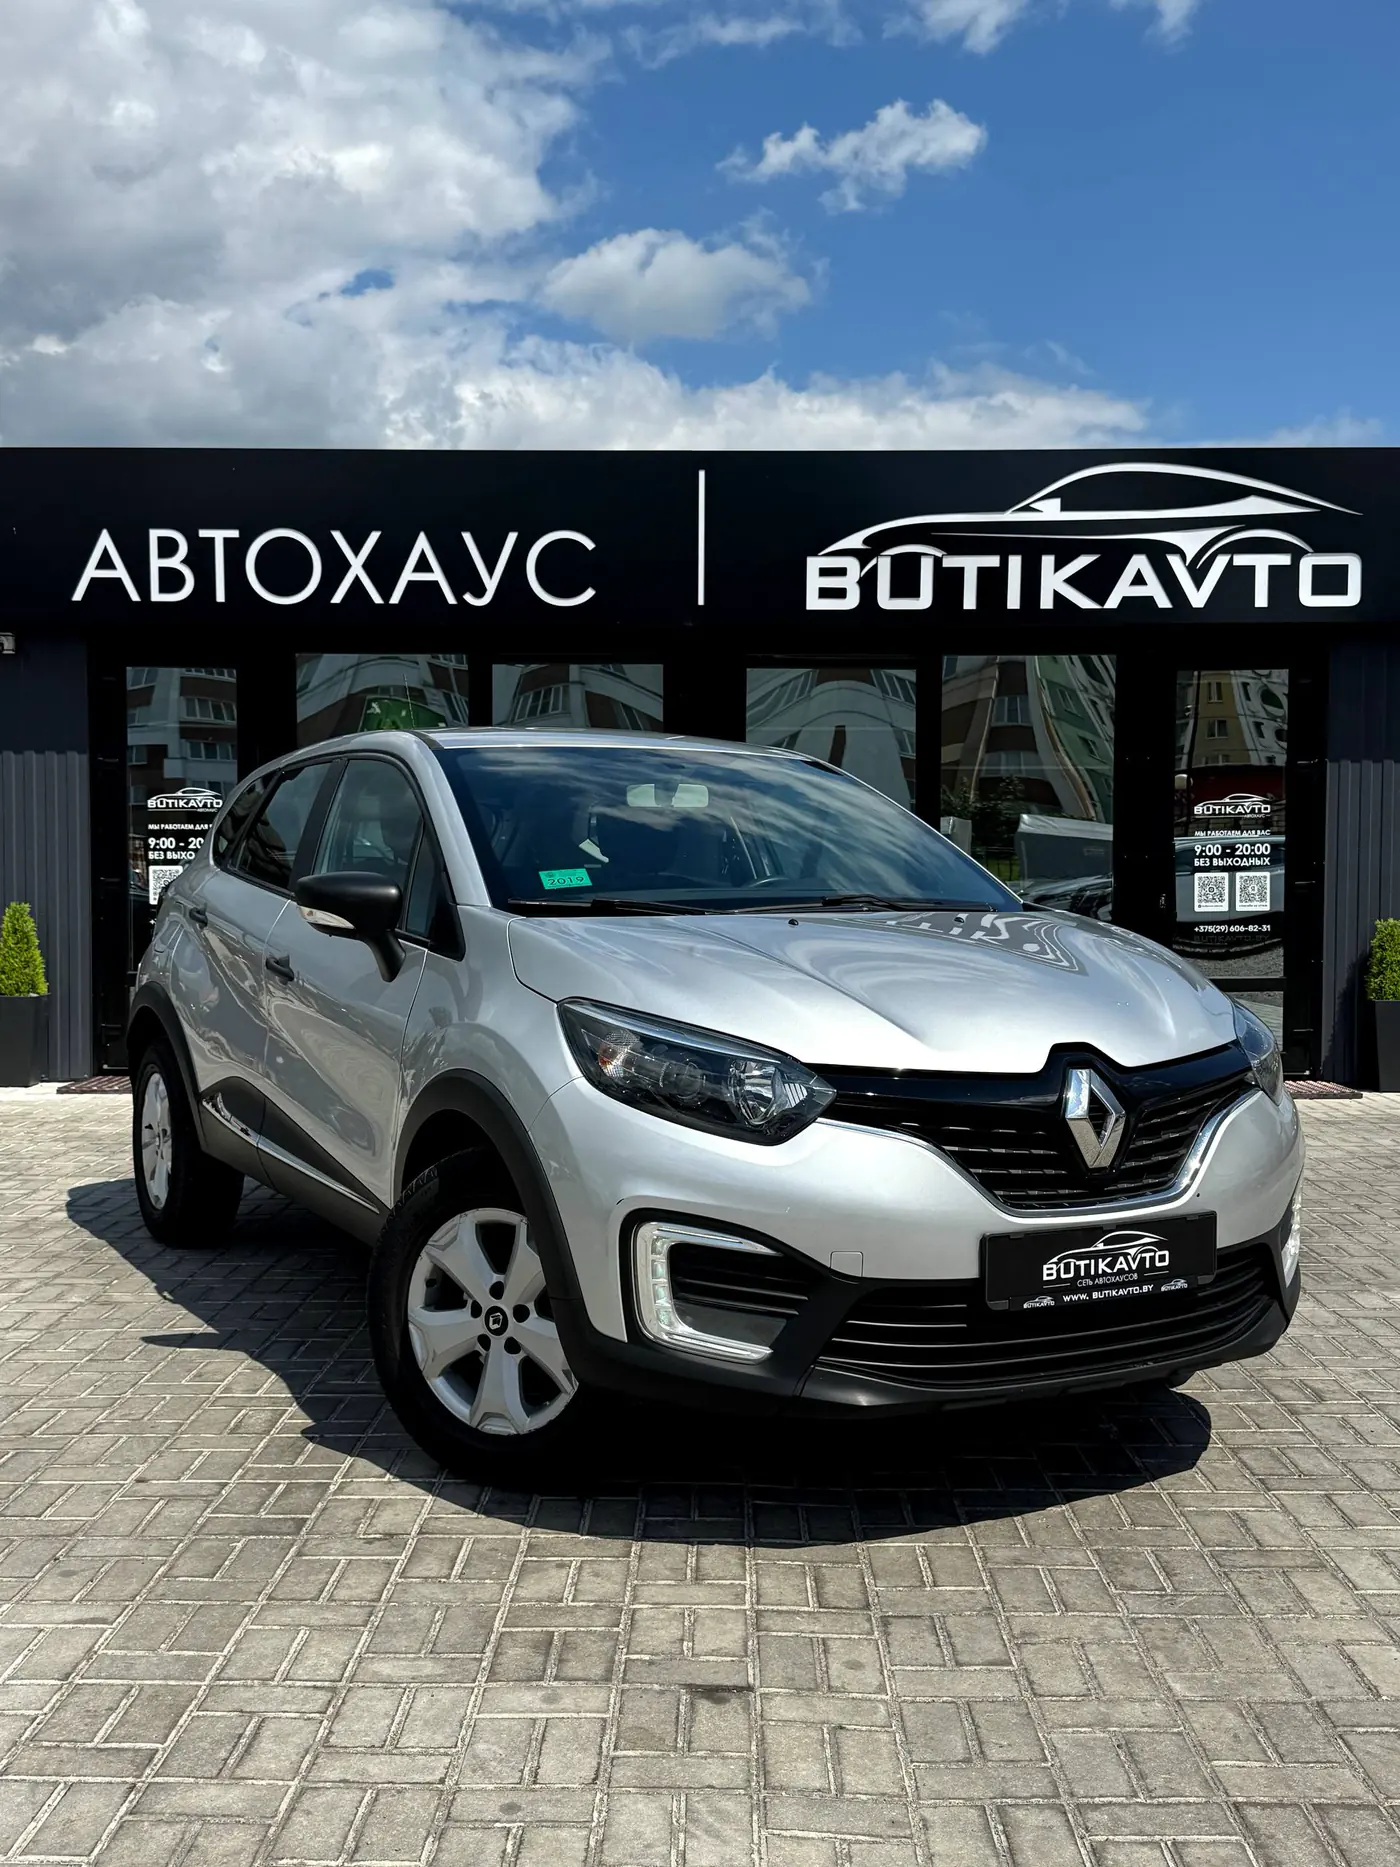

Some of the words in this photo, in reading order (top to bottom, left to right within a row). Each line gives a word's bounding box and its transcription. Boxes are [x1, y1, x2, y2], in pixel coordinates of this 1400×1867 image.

[71, 528, 596, 606] АВТОХАУС
[805, 552, 1363, 611] BUTIKAVTO
[147, 799, 223, 808] BUTIKAVTO
[1194, 804, 1271, 814] BUTIKAVTO
[148, 837, 176, 849] 9:00
[1194, 844, 1222, 856] 9:00
[1235, 843, 1271, 855] 20:00
[148, 851, 165, 860] БЕЗ
[1194, 858, 1211, 867] БЕЗ
[1212, 857, 1271, 867] ВЫХОДНЫХ
[547, 876, 584, 885] 2019
[1043, 1250, 1170, 1281] BUTIKAVTO
[1077, 1279, 1093, 1287] СЕТЬ
[1094, 1273, 1139, 1285] АВТОХАУСОВ
[1092, 1284, 1154, 1299] BUTIKAVTO.BY
[1160, 1283, 1188, 1292] BUTIKAVTO
[1023, 1300, 1055, 1309] BUTIKAVTO
